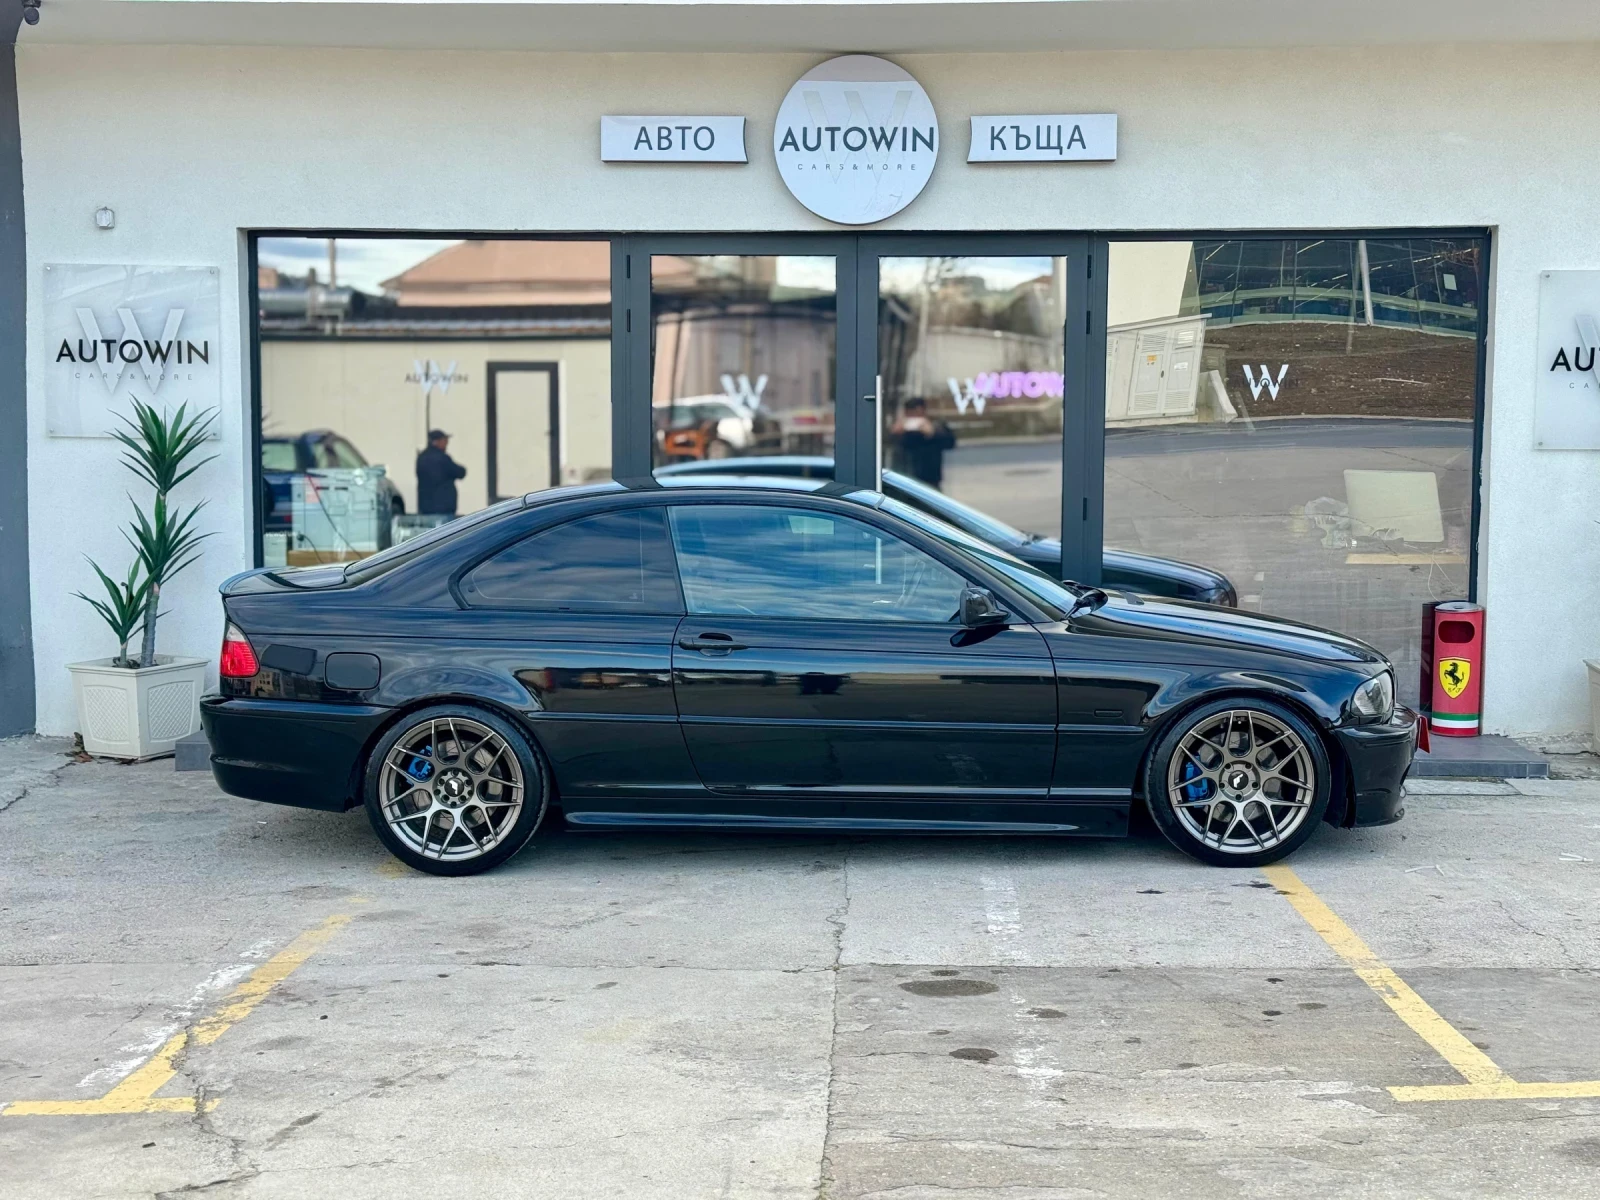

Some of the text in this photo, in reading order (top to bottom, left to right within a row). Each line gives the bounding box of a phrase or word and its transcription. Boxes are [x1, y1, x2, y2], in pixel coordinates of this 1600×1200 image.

[633, 125, 715, 151] АВТО
[778, 126, 935, 152] AUTOWIN
[989, 124, 1087, 155] КЪЩА
[55, 338, 209, 365] AUTOWIN
[1549, 346, 1600, 372] AU
[1242, 364, 1289, 401] W
